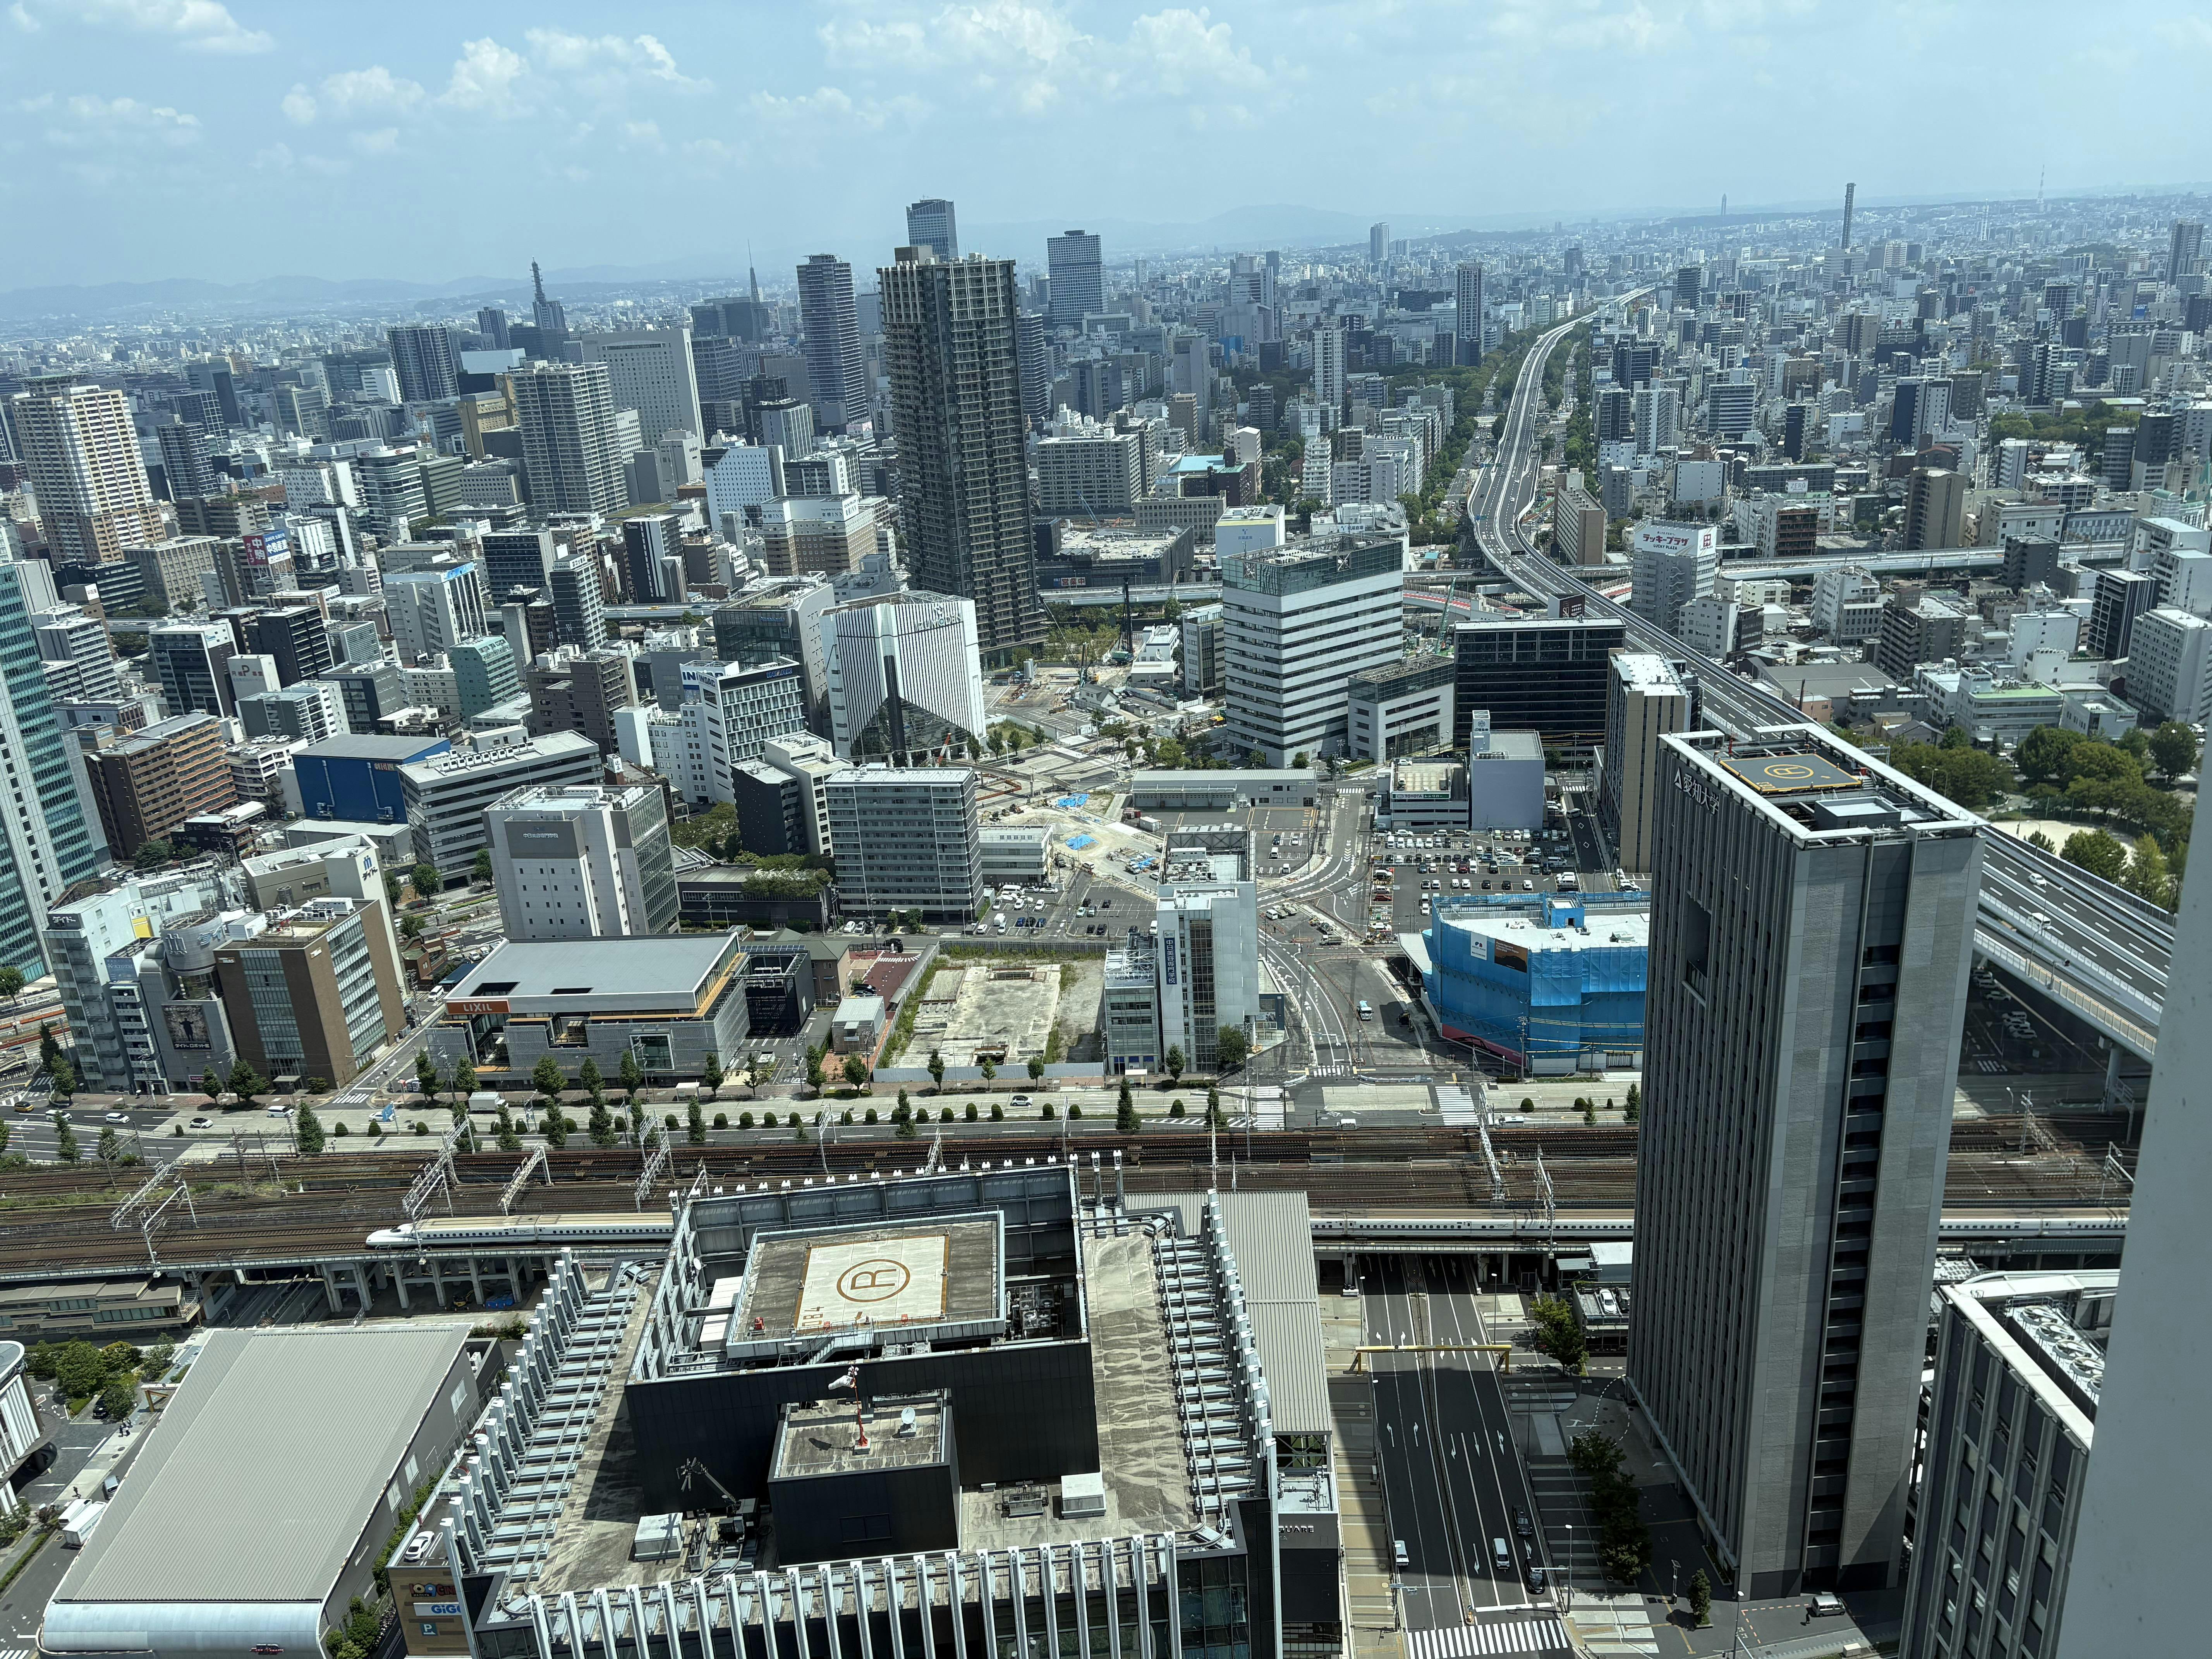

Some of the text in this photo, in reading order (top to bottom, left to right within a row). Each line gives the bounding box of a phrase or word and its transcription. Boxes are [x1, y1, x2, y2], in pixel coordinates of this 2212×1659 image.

[1643, 534, 1690, 546] ラッキープラザ
[246, 543, 255, 563] グループ
[251, 538, 266, 560] 中駒
[915, 614, 962, 631] IZUMODEN
[1683, 773, 1720, 814] 愛知大学
[362, 867, 378, 881] ダイドー
[1166, 939, 1176, 984] 中日美容専門学校
[463, 1003, 492, 1012] LIXIL
[850, 1268, 896, 1290] R
[409, 1583, 437, 1597] 109
[424, 1624, 432, 1632] P
